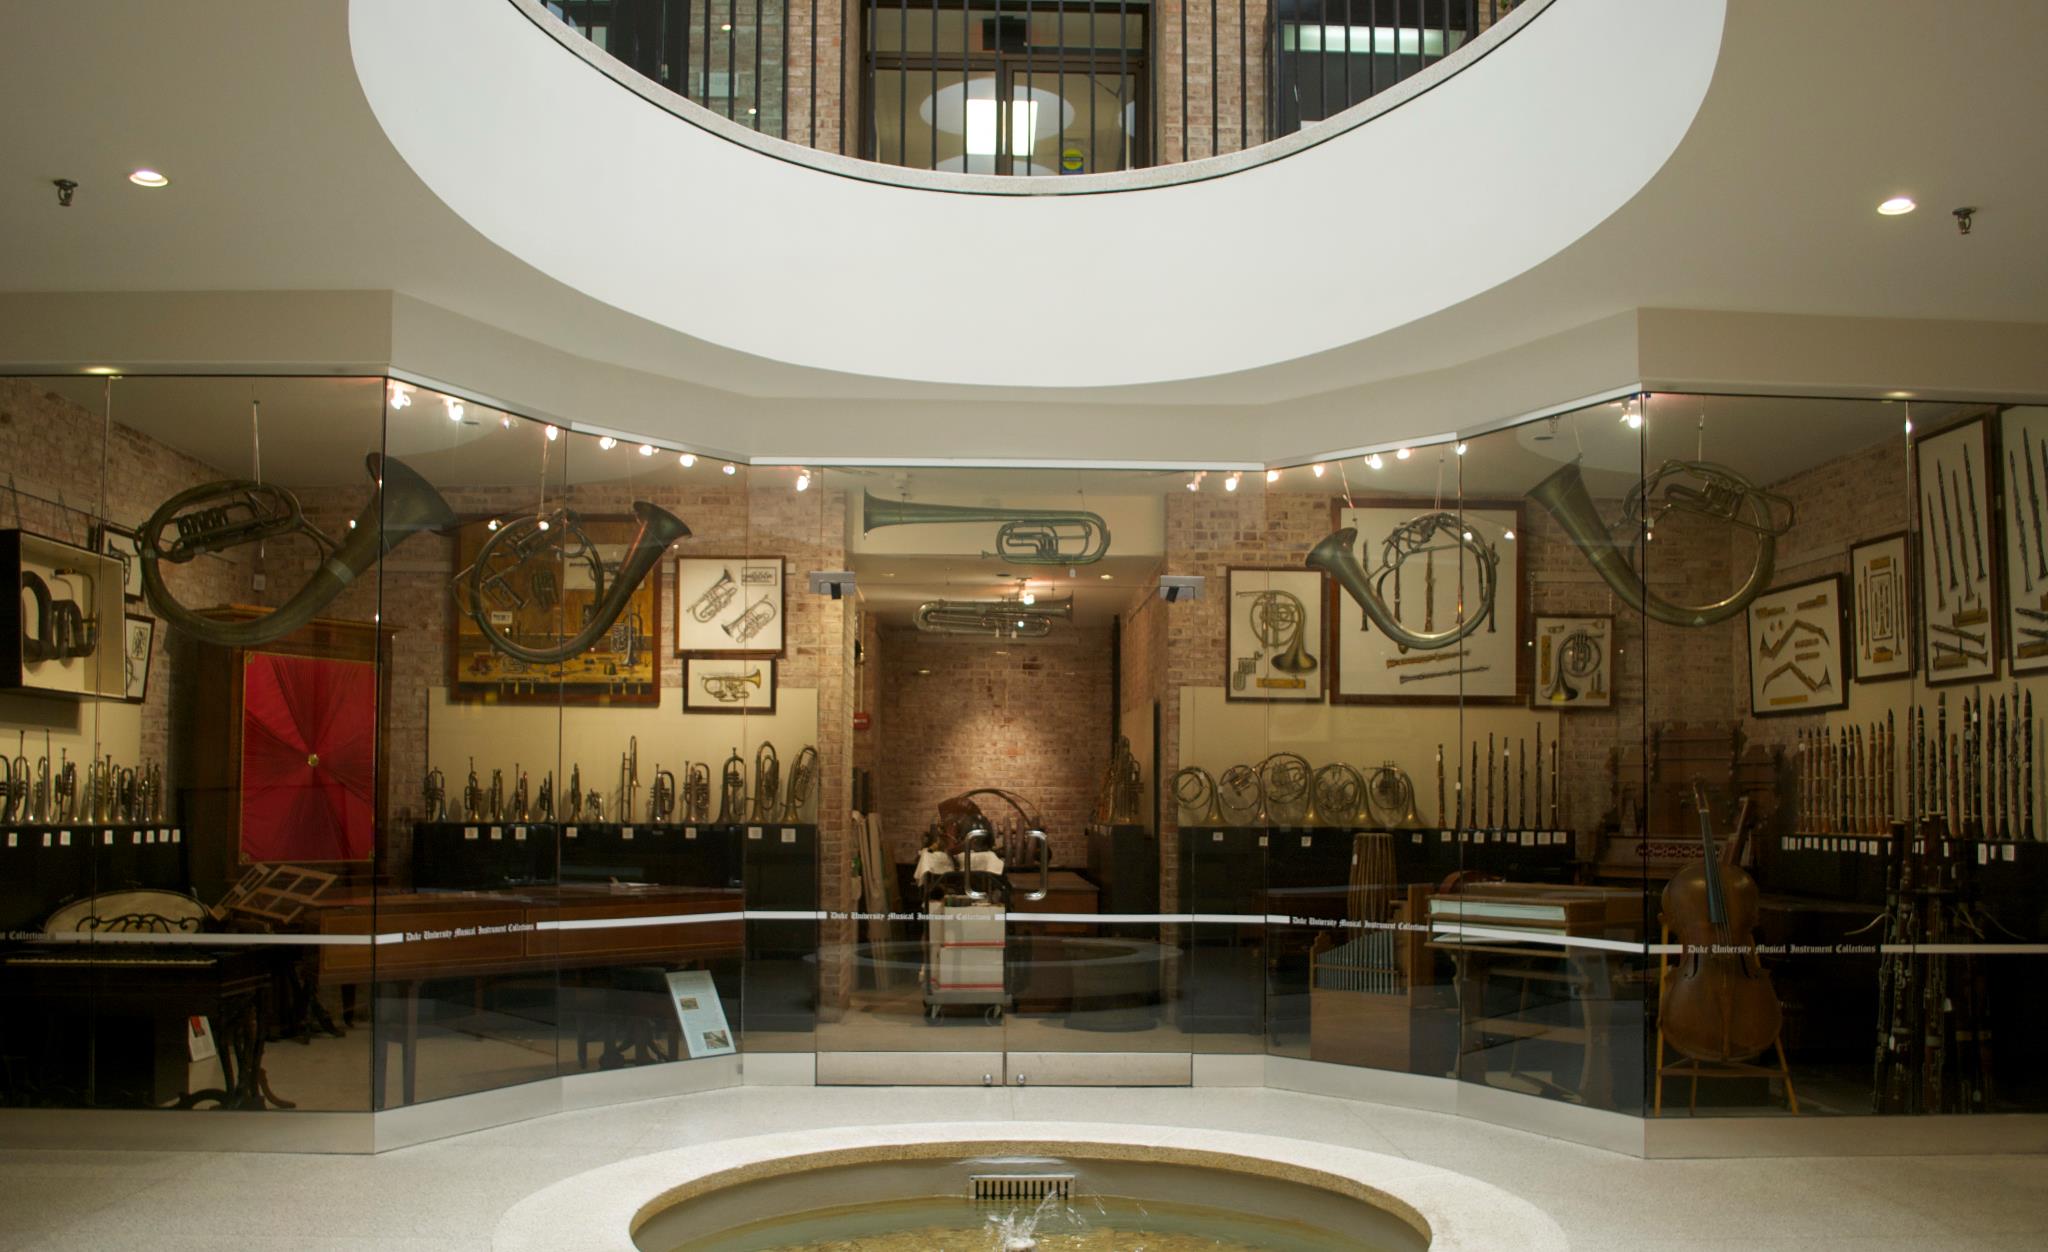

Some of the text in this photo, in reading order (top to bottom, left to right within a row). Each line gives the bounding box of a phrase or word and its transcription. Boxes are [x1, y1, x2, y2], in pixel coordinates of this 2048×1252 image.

[851, 912, 884, 921] University
[887, 912, 914, 920] Musical
[1687, 944, 1876, 955] Duke University Musical Instrument Collections
